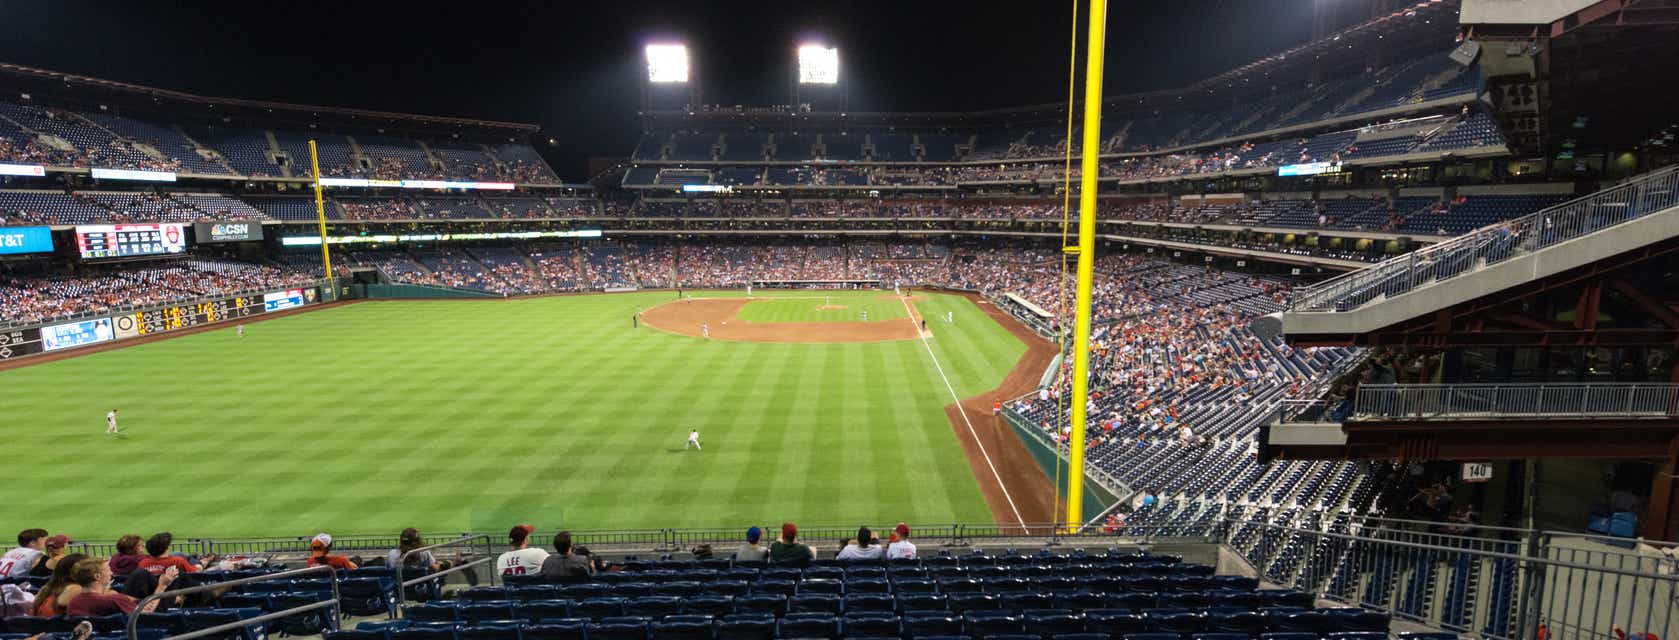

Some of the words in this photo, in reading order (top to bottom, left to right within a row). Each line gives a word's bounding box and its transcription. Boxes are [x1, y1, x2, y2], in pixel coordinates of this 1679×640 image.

[226, 223, 249, 235] CSN
[1470, 463, 1486, 477] 140
[506, 556, 520, 566] LEE
